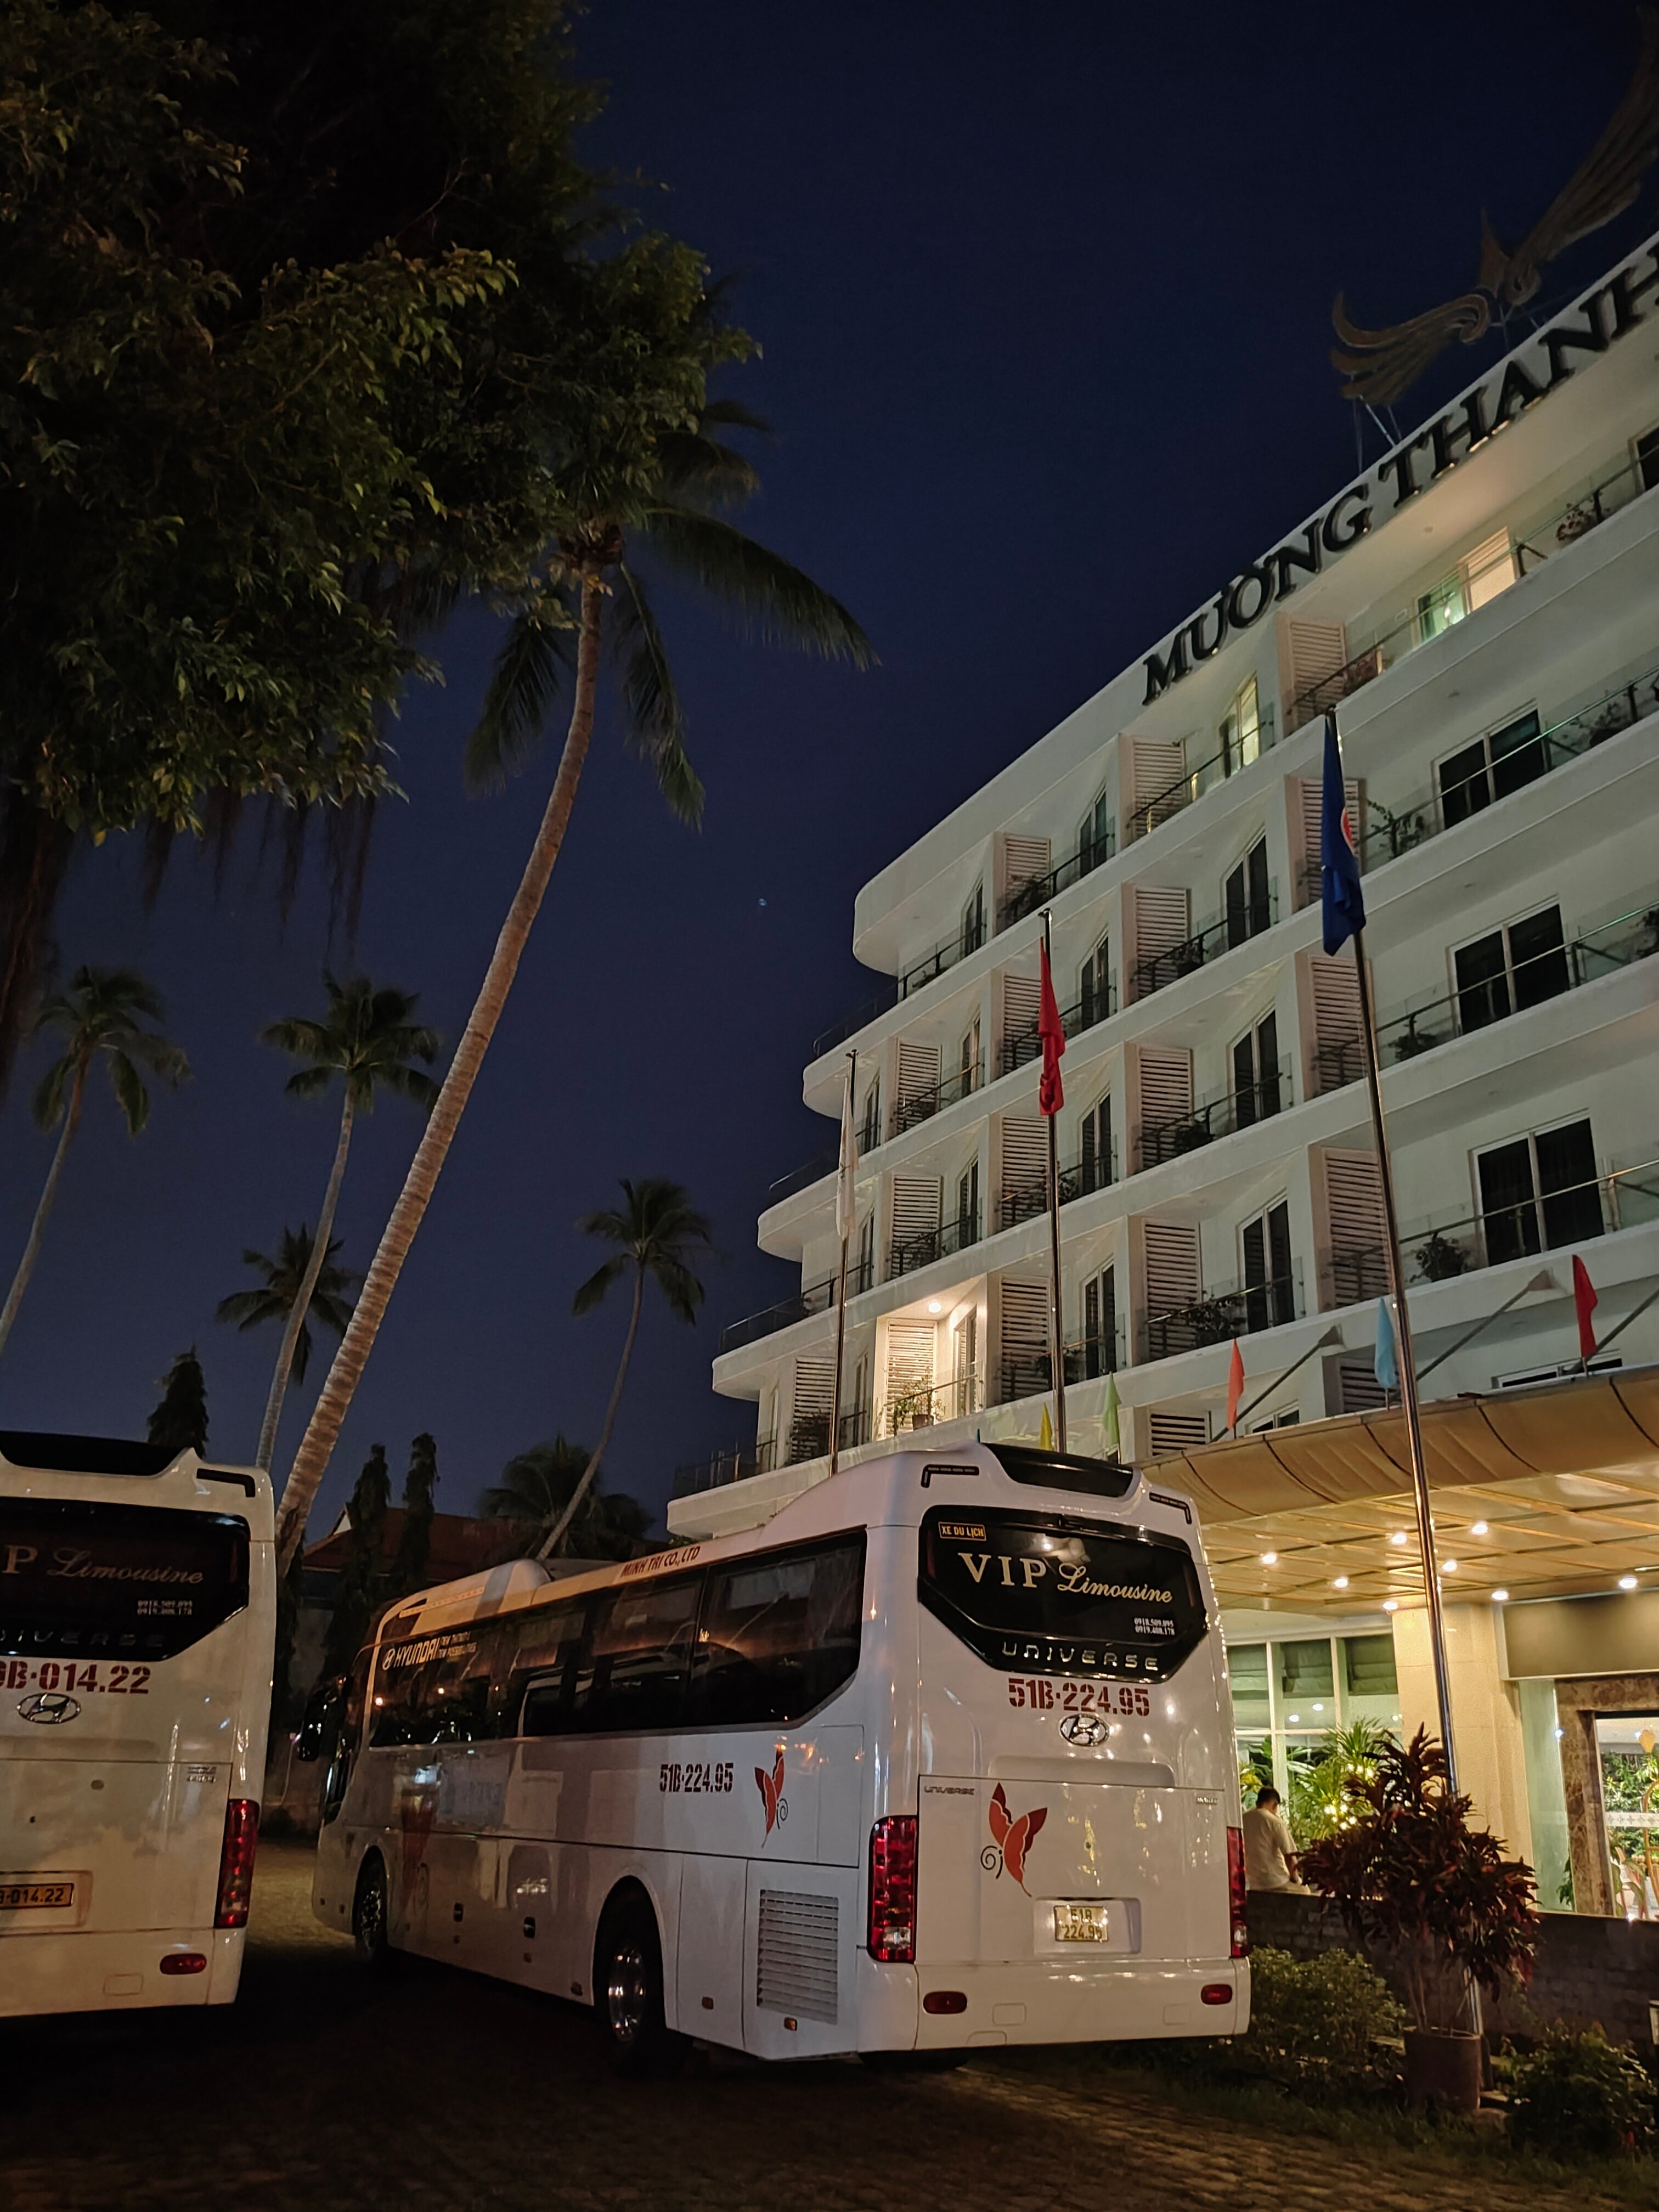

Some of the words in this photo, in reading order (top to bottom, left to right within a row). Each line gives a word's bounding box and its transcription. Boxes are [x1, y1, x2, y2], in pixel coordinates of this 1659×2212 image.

[1378, 241, 1659, 508] THANH
[941, 1525, 952, 1535] XE
[953, 1526, 964, 1536] DU
[47, 1547, 203, 1584] Limousine
[620, 1559, 648, 1578] MINH
[958, 1553, 1047, 1588] VIP
[1057, 1562, 1173, 1603] Limousine
[393, 1637, 440, 1668] HYUNDAI
[1002, 1641, 1159, 1671] UNIVERSE
[924, 1785, 975, 1796] UNIVERSE
